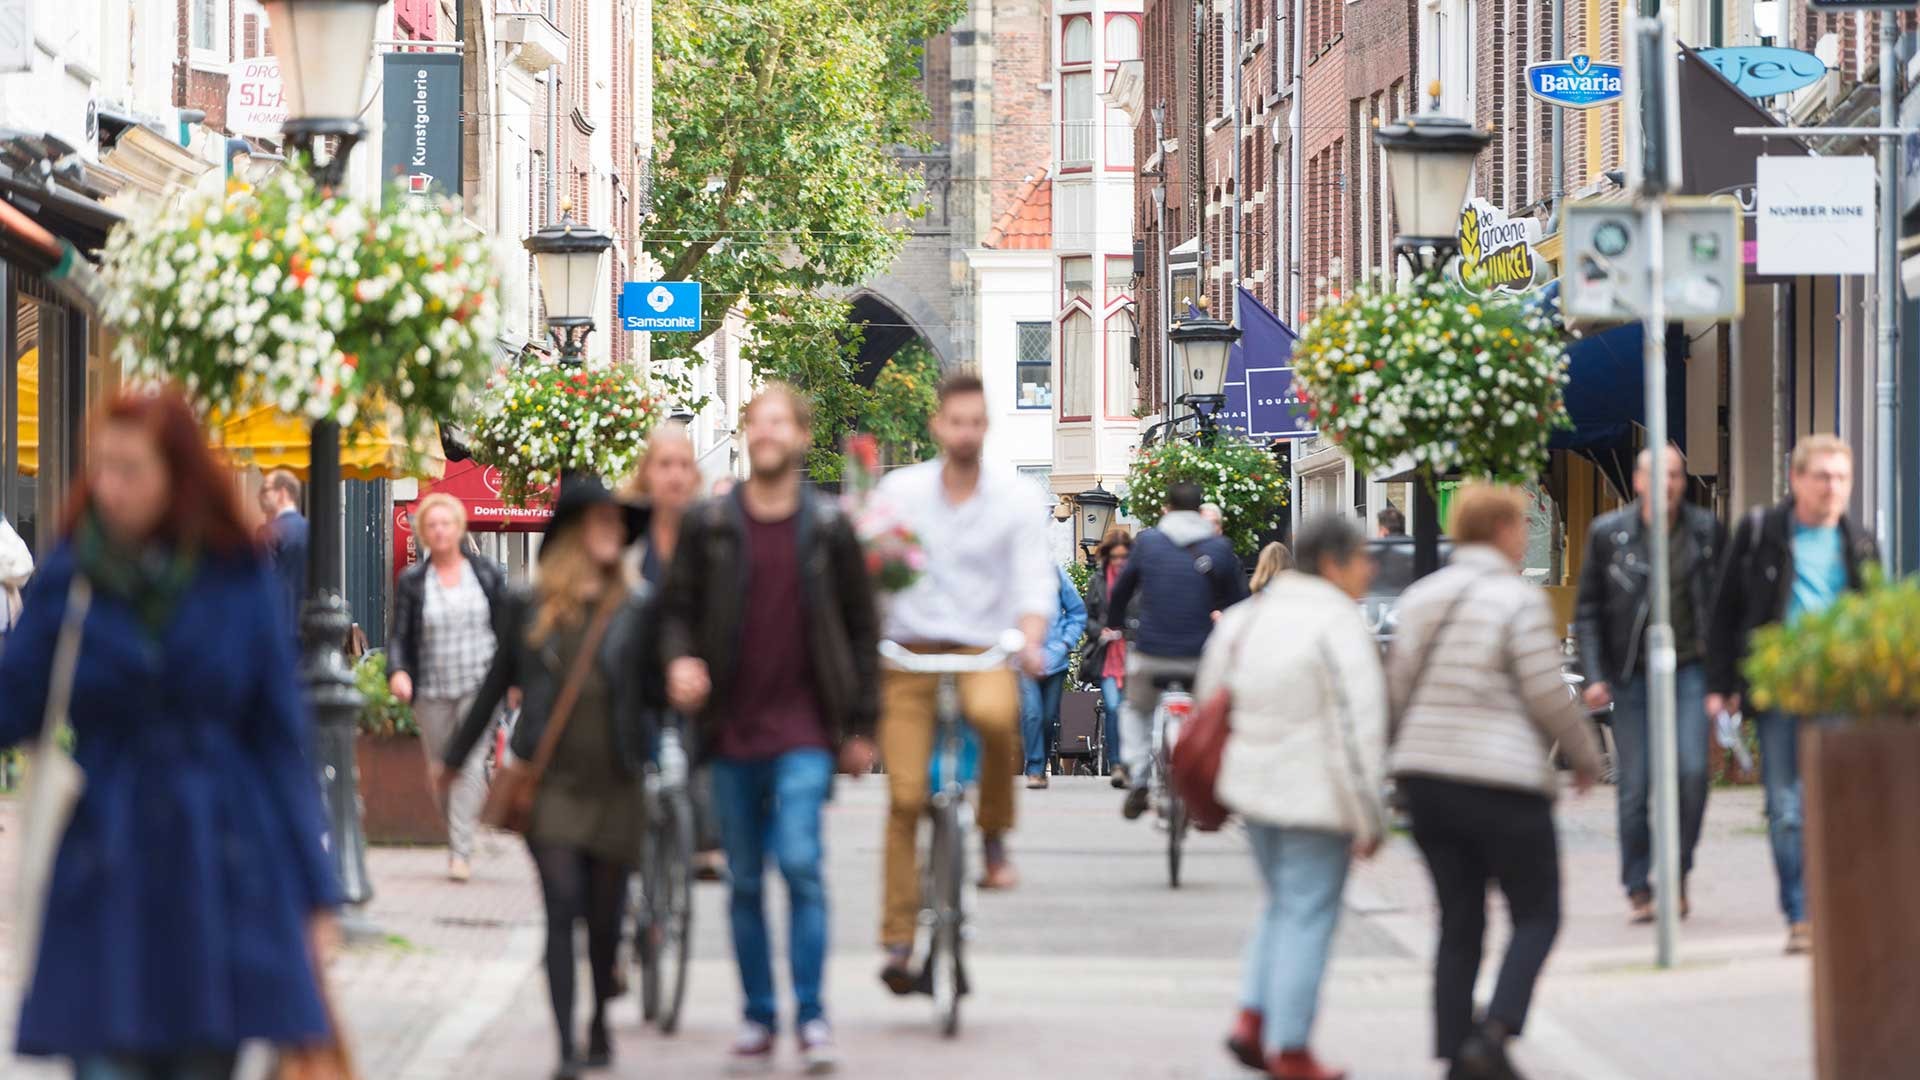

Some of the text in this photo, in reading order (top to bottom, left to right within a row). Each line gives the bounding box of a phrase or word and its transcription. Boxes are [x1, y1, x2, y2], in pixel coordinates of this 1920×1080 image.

[1540, 73, 1622, 93] Bavaria
[412, 69, 430, 166] Kunstgalerie
[1480, 210, 1493, 228] de
[1769, 205, 1864, 216] NUMBER NINE
[1481, 222, 1526, 254] groene
[627, 316, 696, 328] Samsonite
[474, 506, 556, 518] DOMTORENTJES
